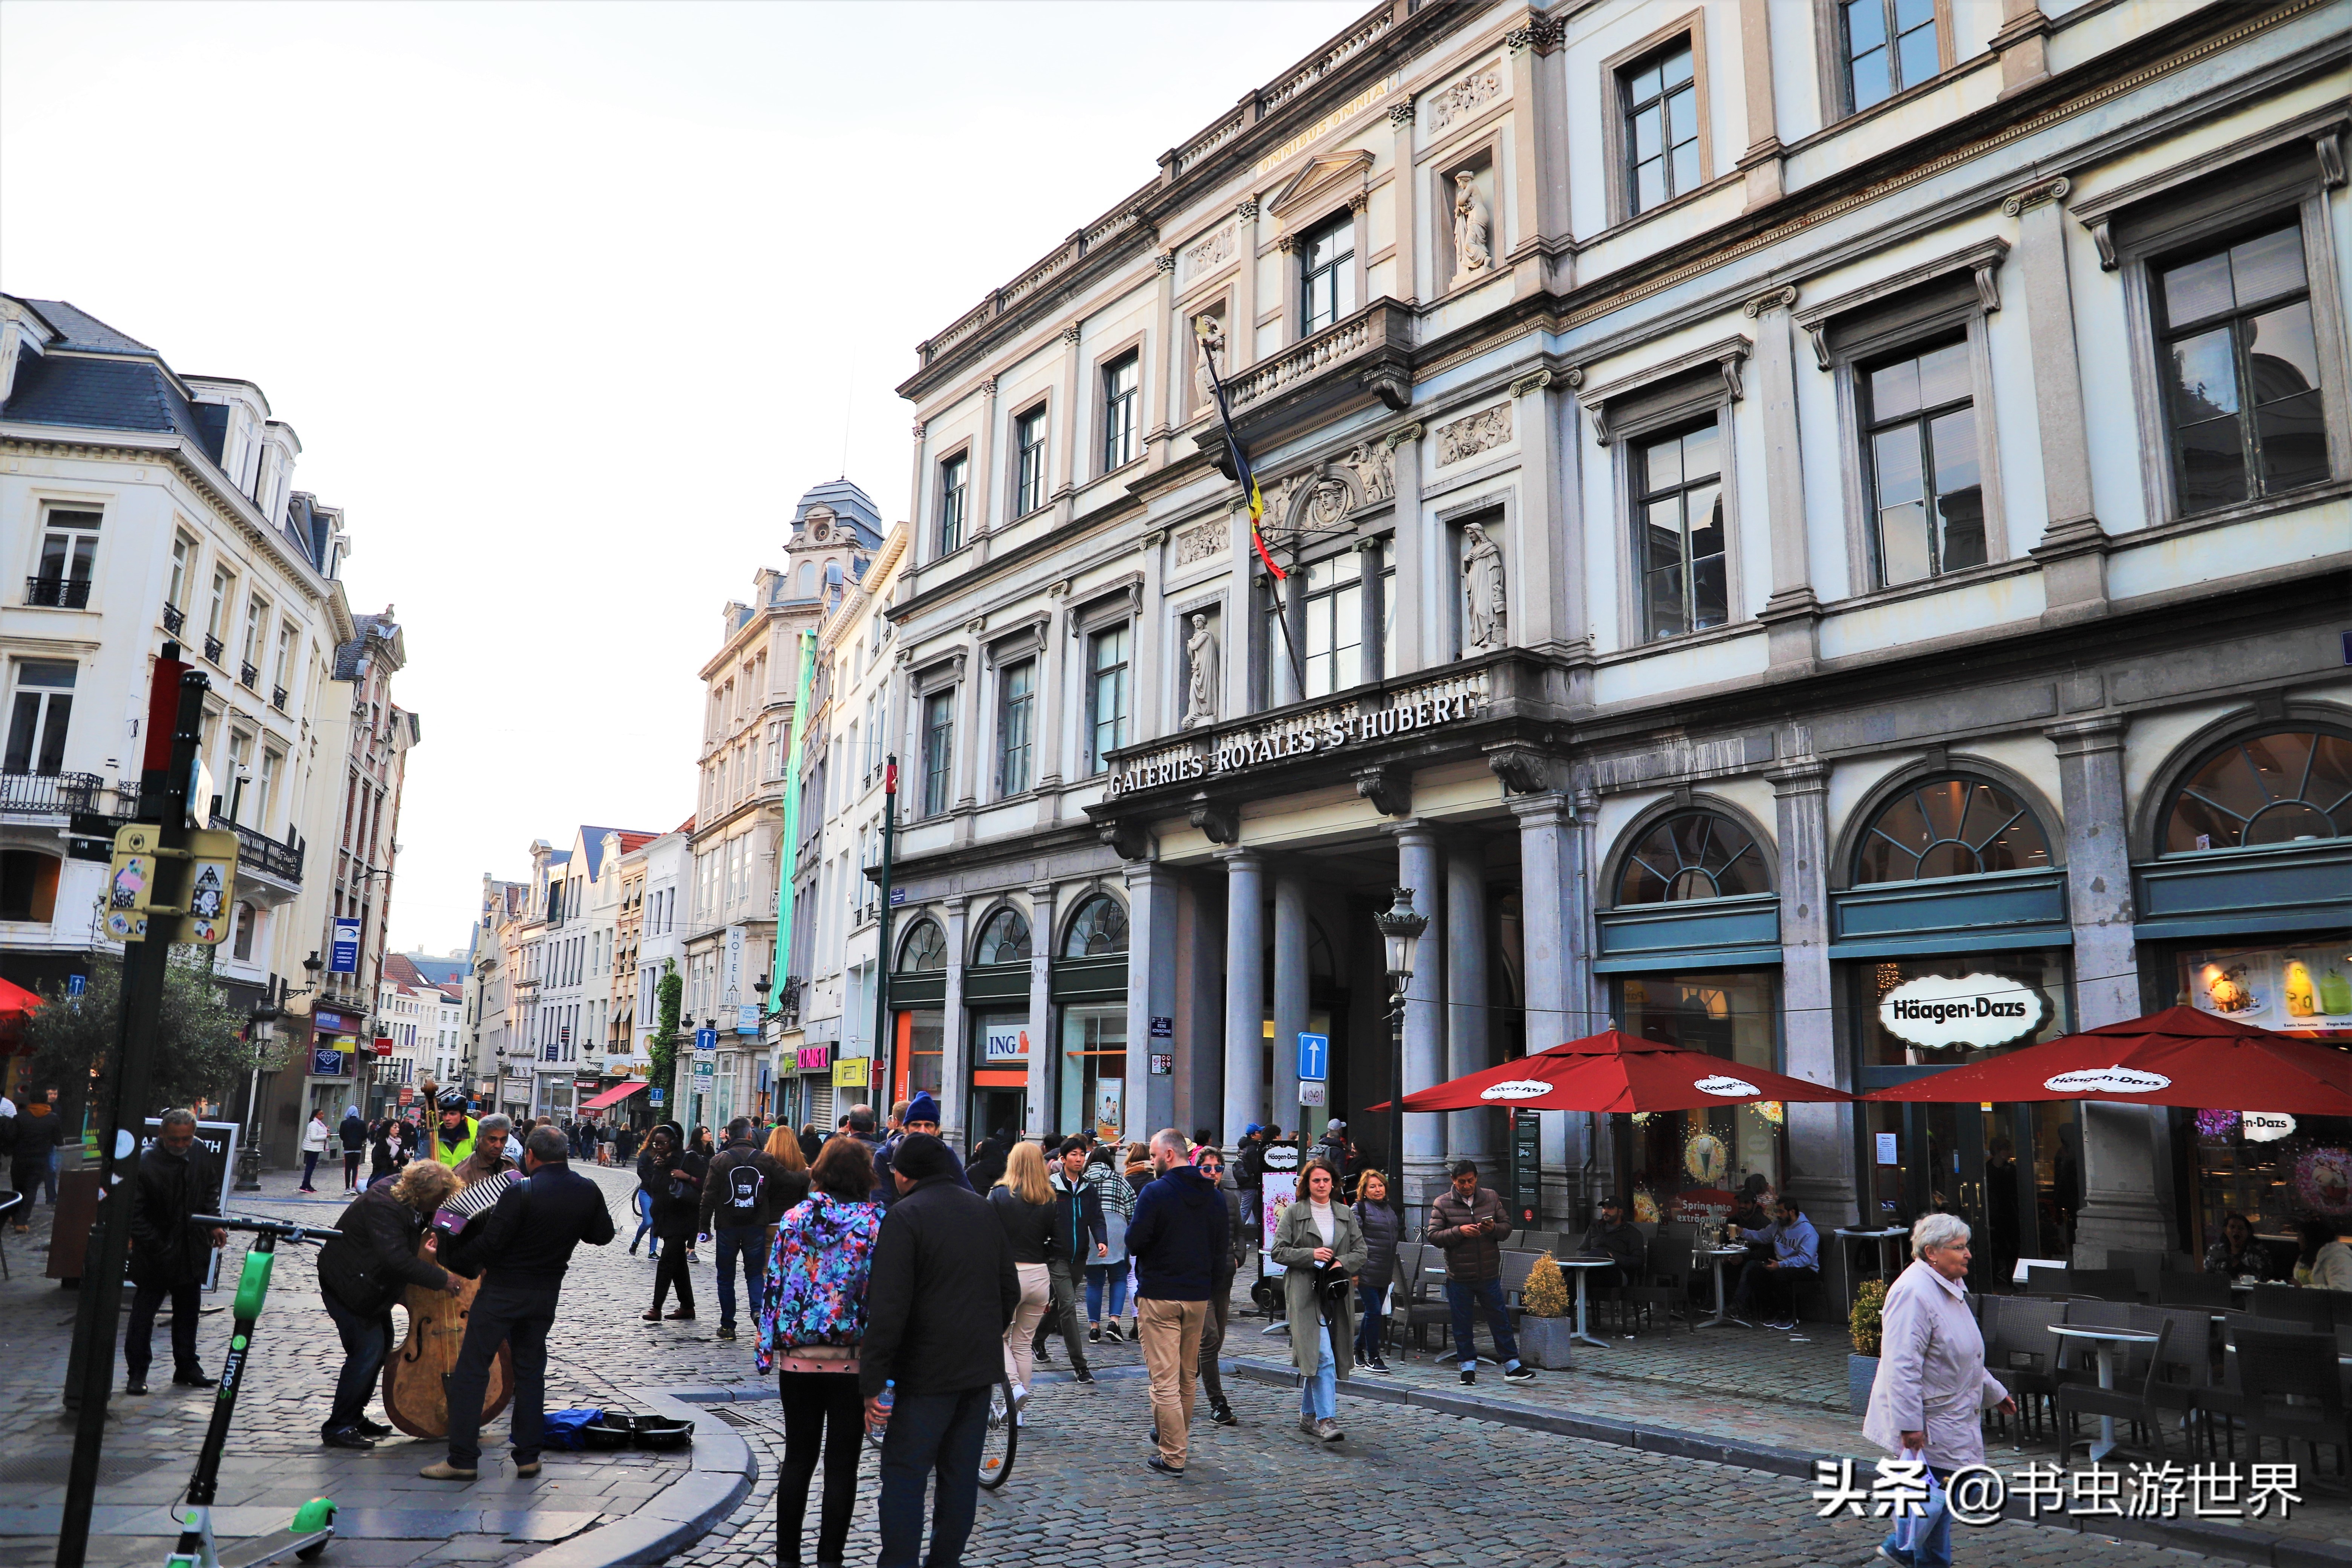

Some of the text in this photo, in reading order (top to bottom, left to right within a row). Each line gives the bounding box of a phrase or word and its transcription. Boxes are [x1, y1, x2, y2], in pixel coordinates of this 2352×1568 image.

[1262, 84, 1386, 172] OMNIBUS OMNIA
[1110, 755, 1204, 796] GALERIES
[1217, 728, 1317, 772] ROYALES
[1361, 692, 1471, 740] HUBERT
[731, 931, 740, 983] HOTEL
[725, 993, 741, 1004] ARIS
[1894, 997, 2026, 1024] Häagen-Dazs
[989, 1036, 1016, 1054] ING
[805, 1047, 819, 1068] PARIS
[820, 1047, 827, 1067] XL
[2052, 1075, 2161, 1086] Häagen-Dazs
[1268, 1153, 1298, 1161] Häagen-Dazs
[1682, 1200, 1732, 1213] Spring into
